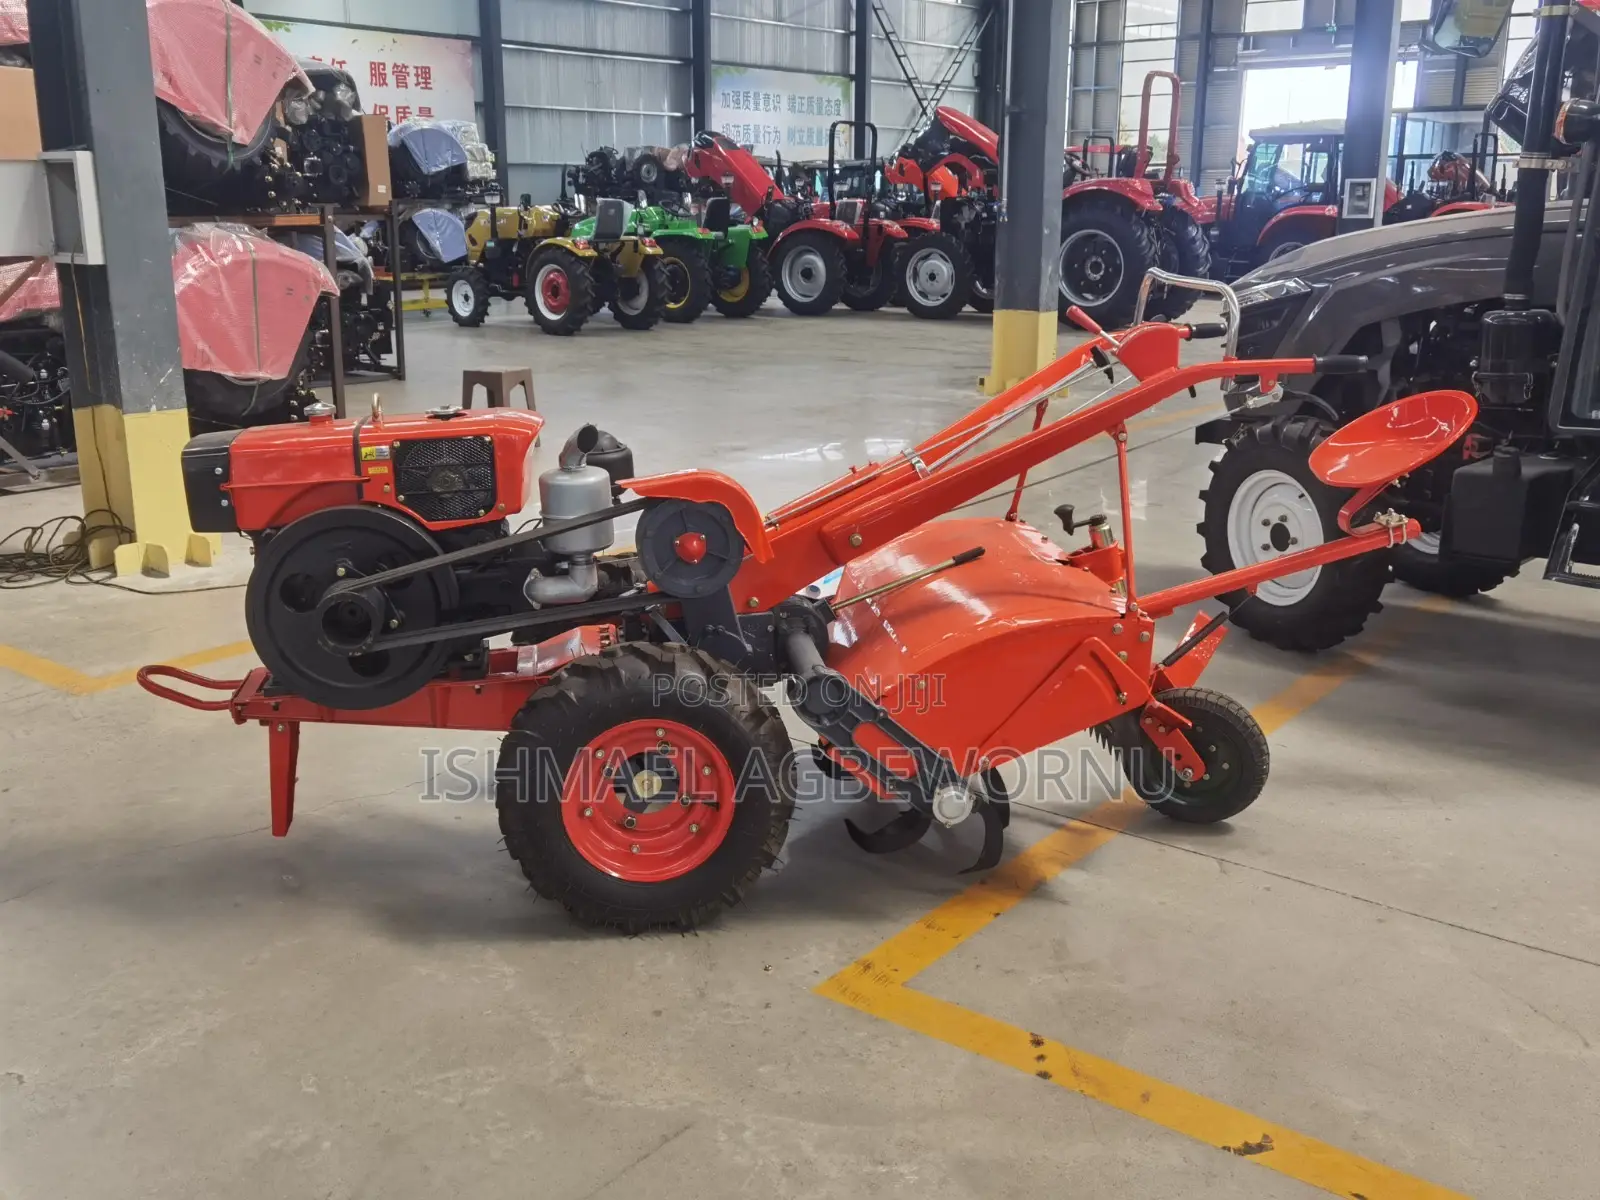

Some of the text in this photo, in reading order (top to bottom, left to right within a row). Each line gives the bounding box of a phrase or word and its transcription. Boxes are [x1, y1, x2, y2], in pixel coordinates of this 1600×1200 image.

[369, 61, 433, 90] 服管理
[721, 90, 781, 113] 加强质量意识
